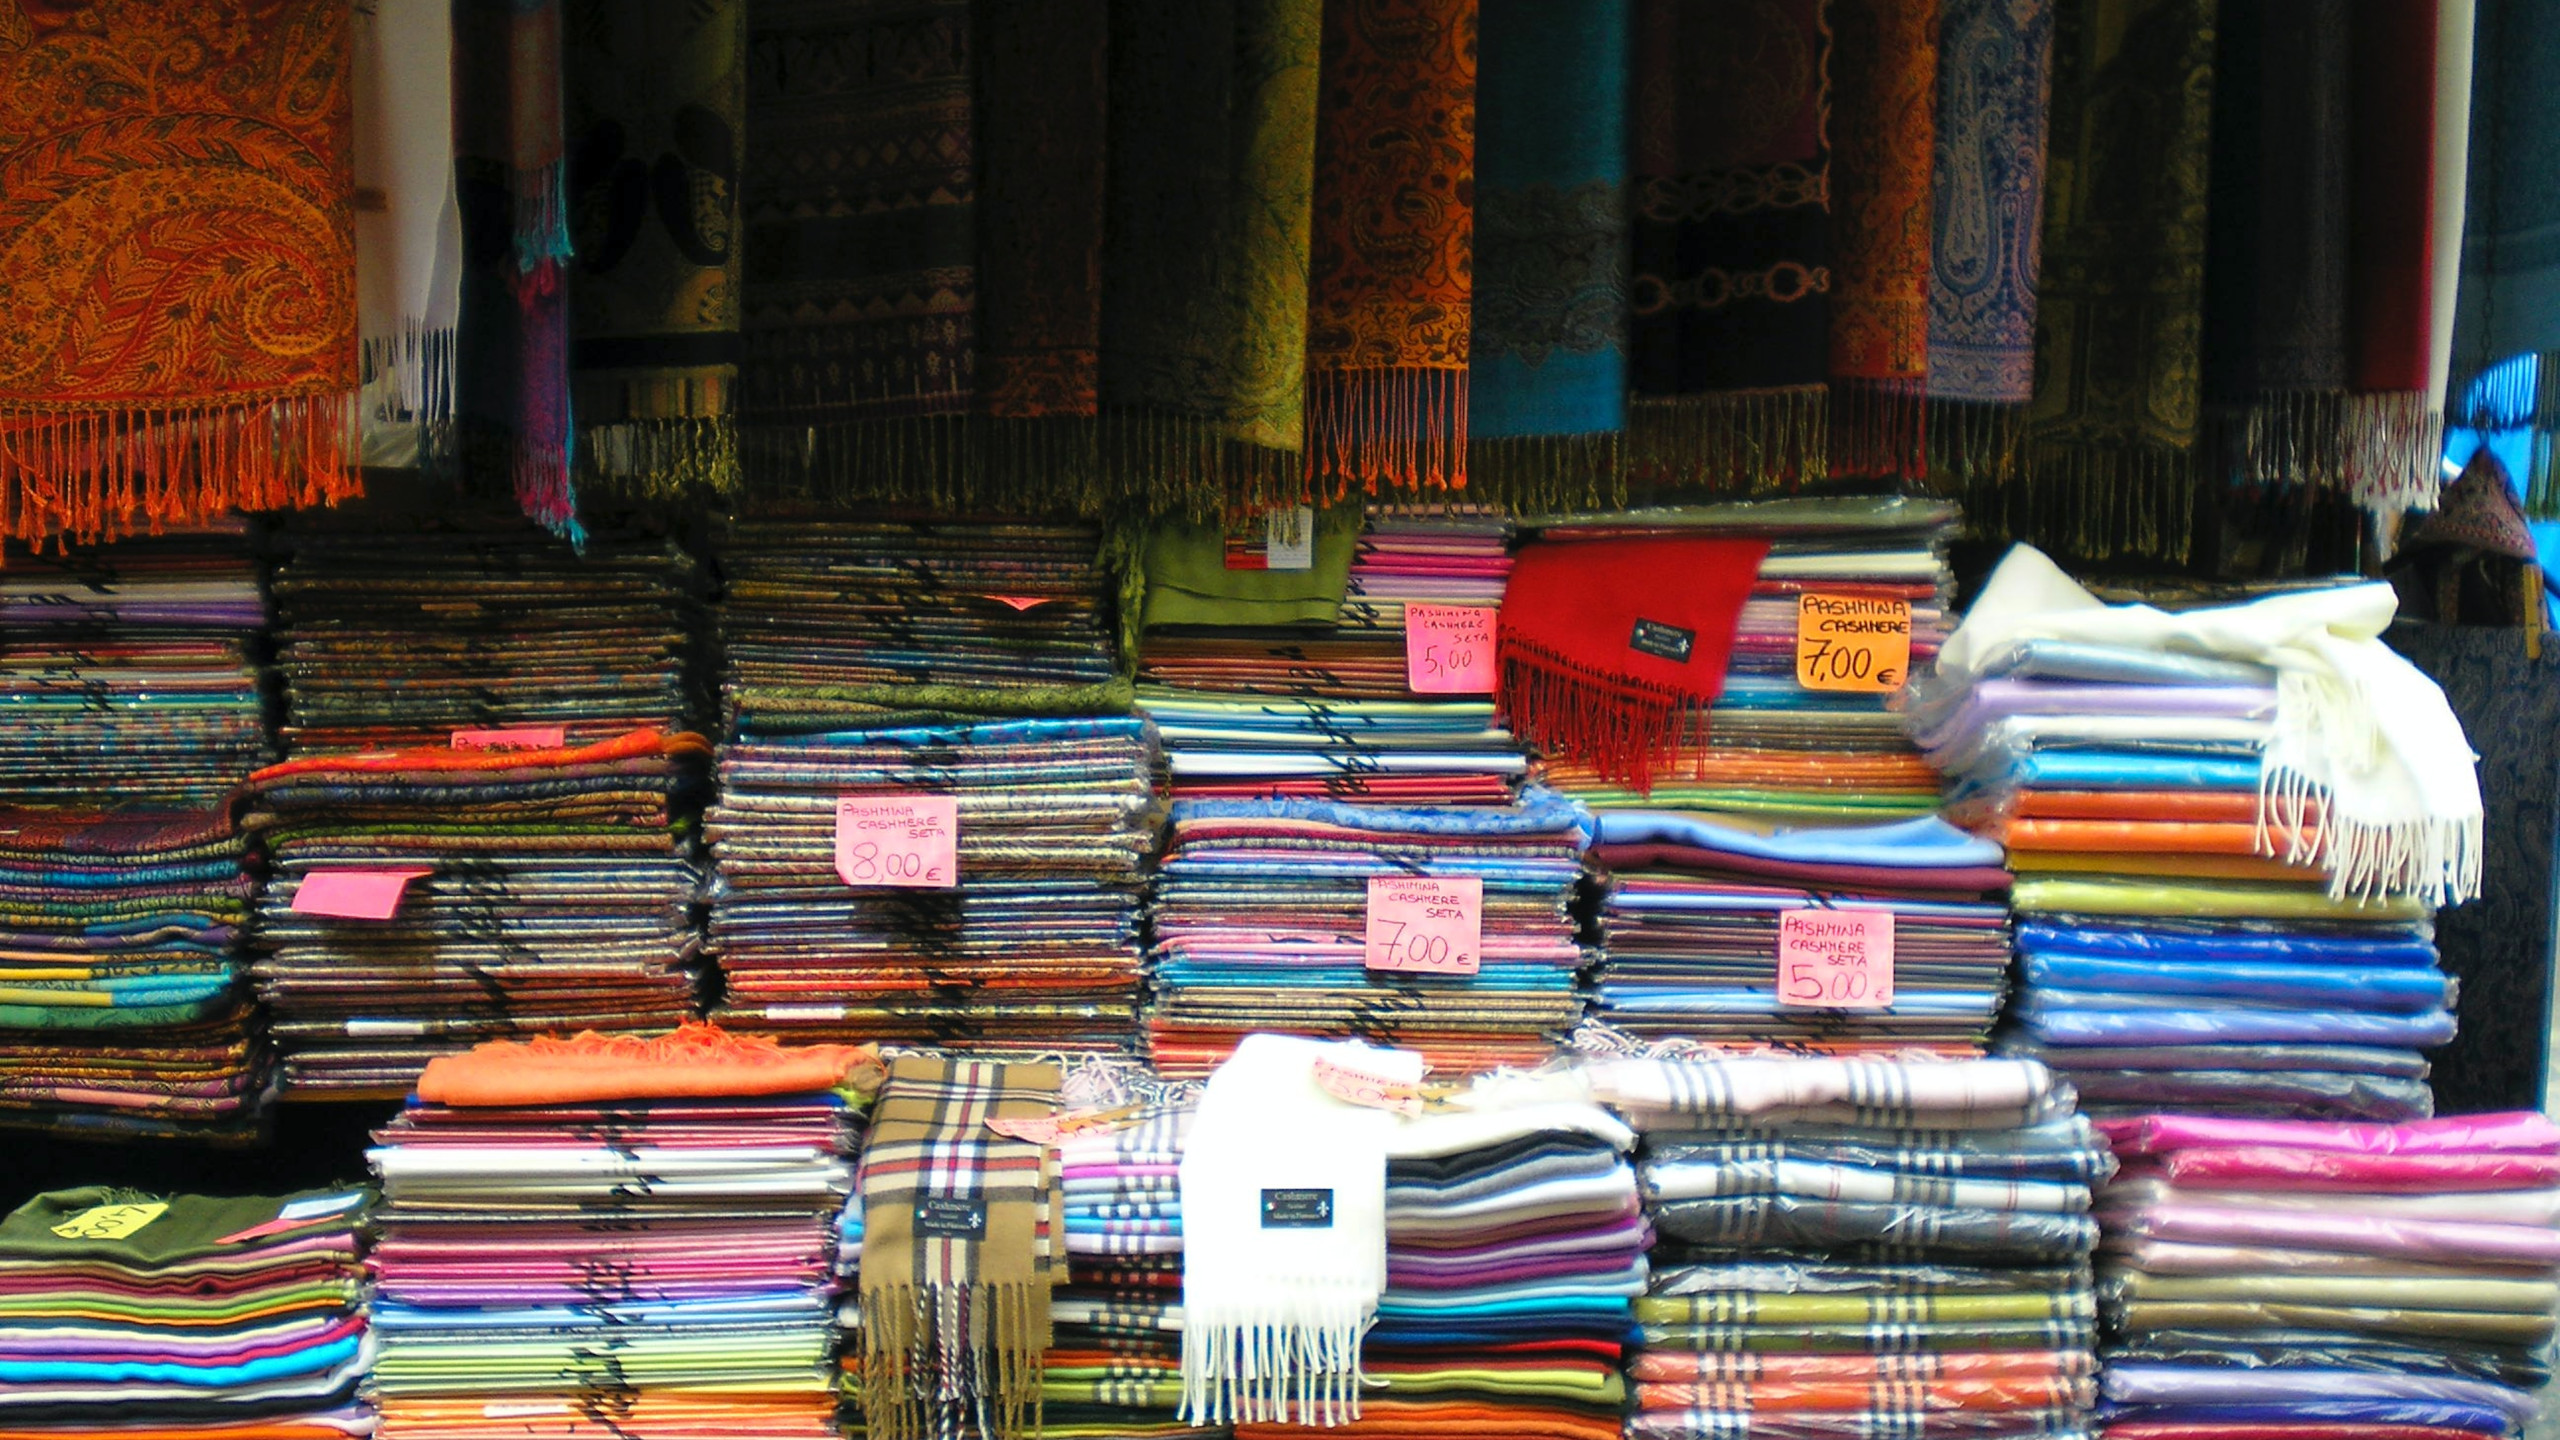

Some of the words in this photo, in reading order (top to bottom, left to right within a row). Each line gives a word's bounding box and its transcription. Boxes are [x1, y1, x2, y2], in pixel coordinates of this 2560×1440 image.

[1803, 596, 1906, 616] PASHMINA
[1453, 633, 1489, 645] SETA
[1425, 645, 1472, 678] 5,00
[1804, 637, 1872, 681] 7,00
[1876, 668, 1900, 685] €
[842, 803, 914, 817] PASHMINA
[908, 828, 945, 839] SETA
[852, 841, 921, 883] 8,00
[925, 867, 942, 881] €
[1388, 893, 1460, 905] CASHMERE
[1425, 907, 1464, 920] SETA
[1785, 916, 1865, 937] PASHMINA
[1377, 918, 1448, 967] 7,00
[1456, 953, 1472, 965] €
[1790, 939, 1865, 954] CASHMERE
[1827, 954, 1868, 968] SETA
